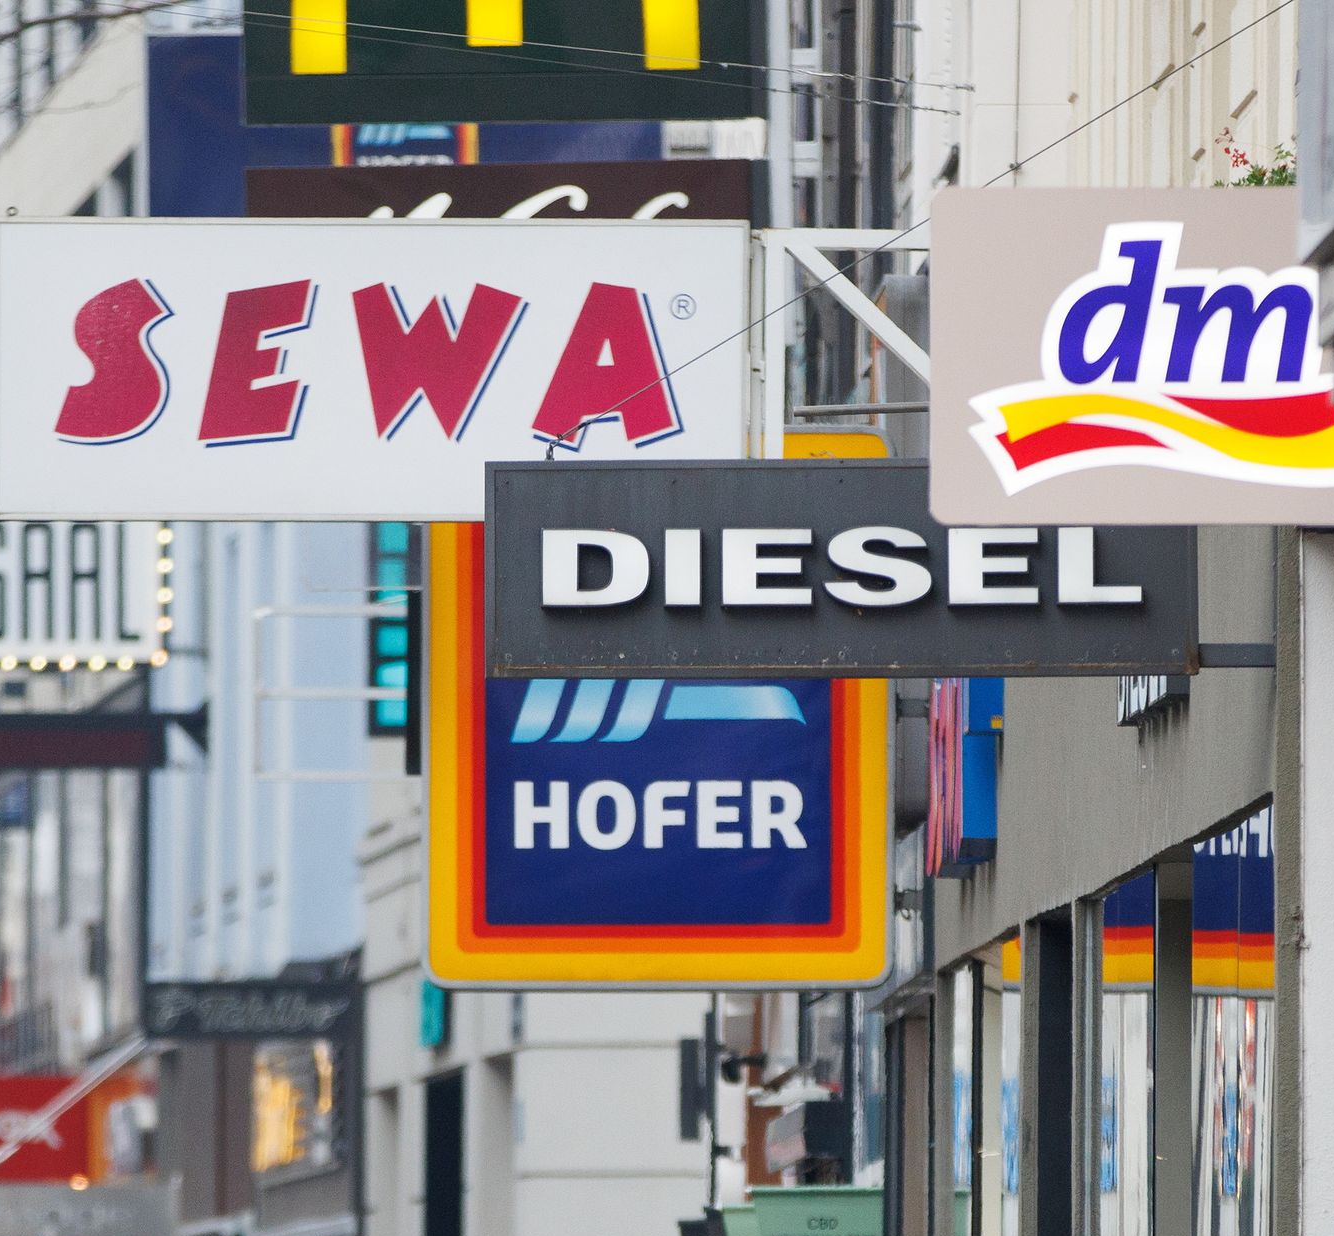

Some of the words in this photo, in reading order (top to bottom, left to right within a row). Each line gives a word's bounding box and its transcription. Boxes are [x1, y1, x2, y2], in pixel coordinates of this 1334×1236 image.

[54, 278, 685, 451] SEWA
[1057, 239, 1315, 384] dm
[541, 525, 1143, 607] DIESEL
[512, 779, 807, 851] HOFER
